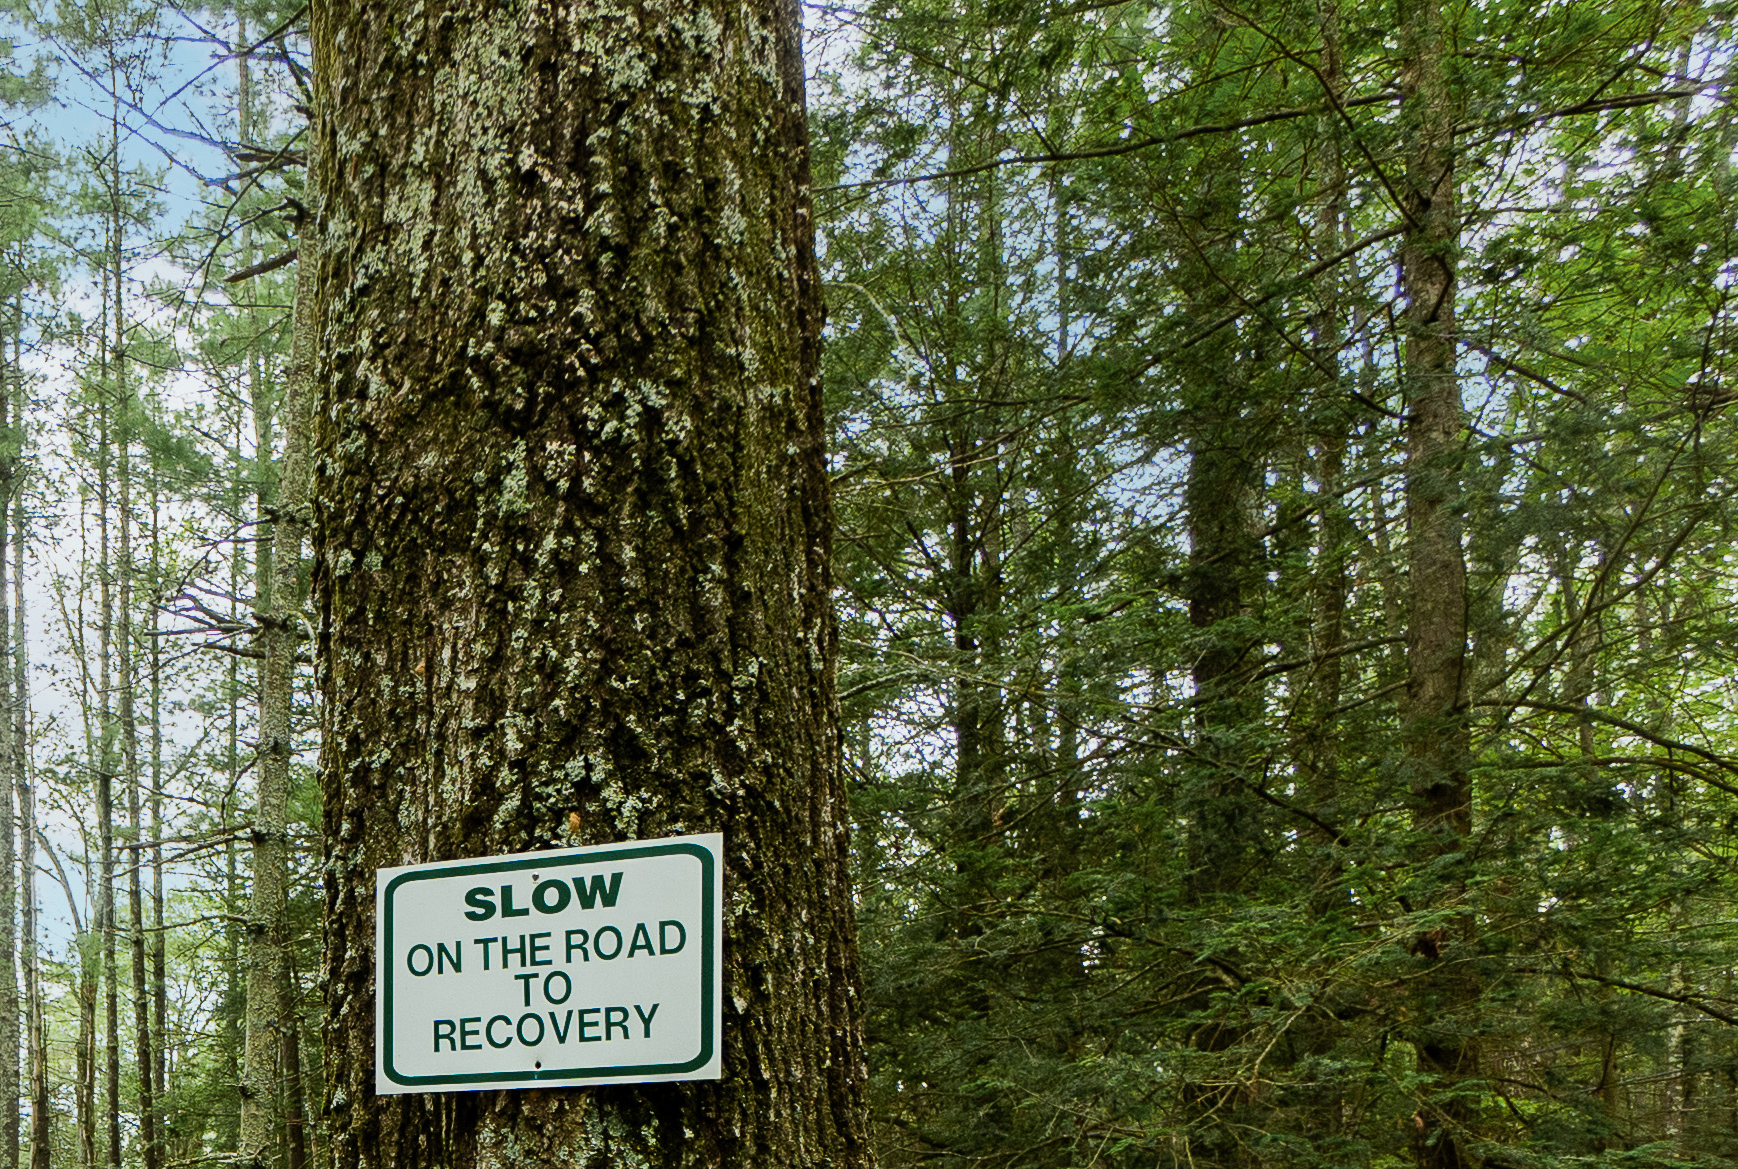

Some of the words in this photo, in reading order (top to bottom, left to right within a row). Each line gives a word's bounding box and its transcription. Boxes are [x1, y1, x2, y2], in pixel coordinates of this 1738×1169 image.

[464, 872, 624, 921] SLOW
[407, 941, 462, 977] ON
[474, 932, 552, 970] THE
[565, 920, 687, 963] ROAD
[514, 971, 572, 1007] TO
[433, 1003, 660, 1053] RECOVERY
